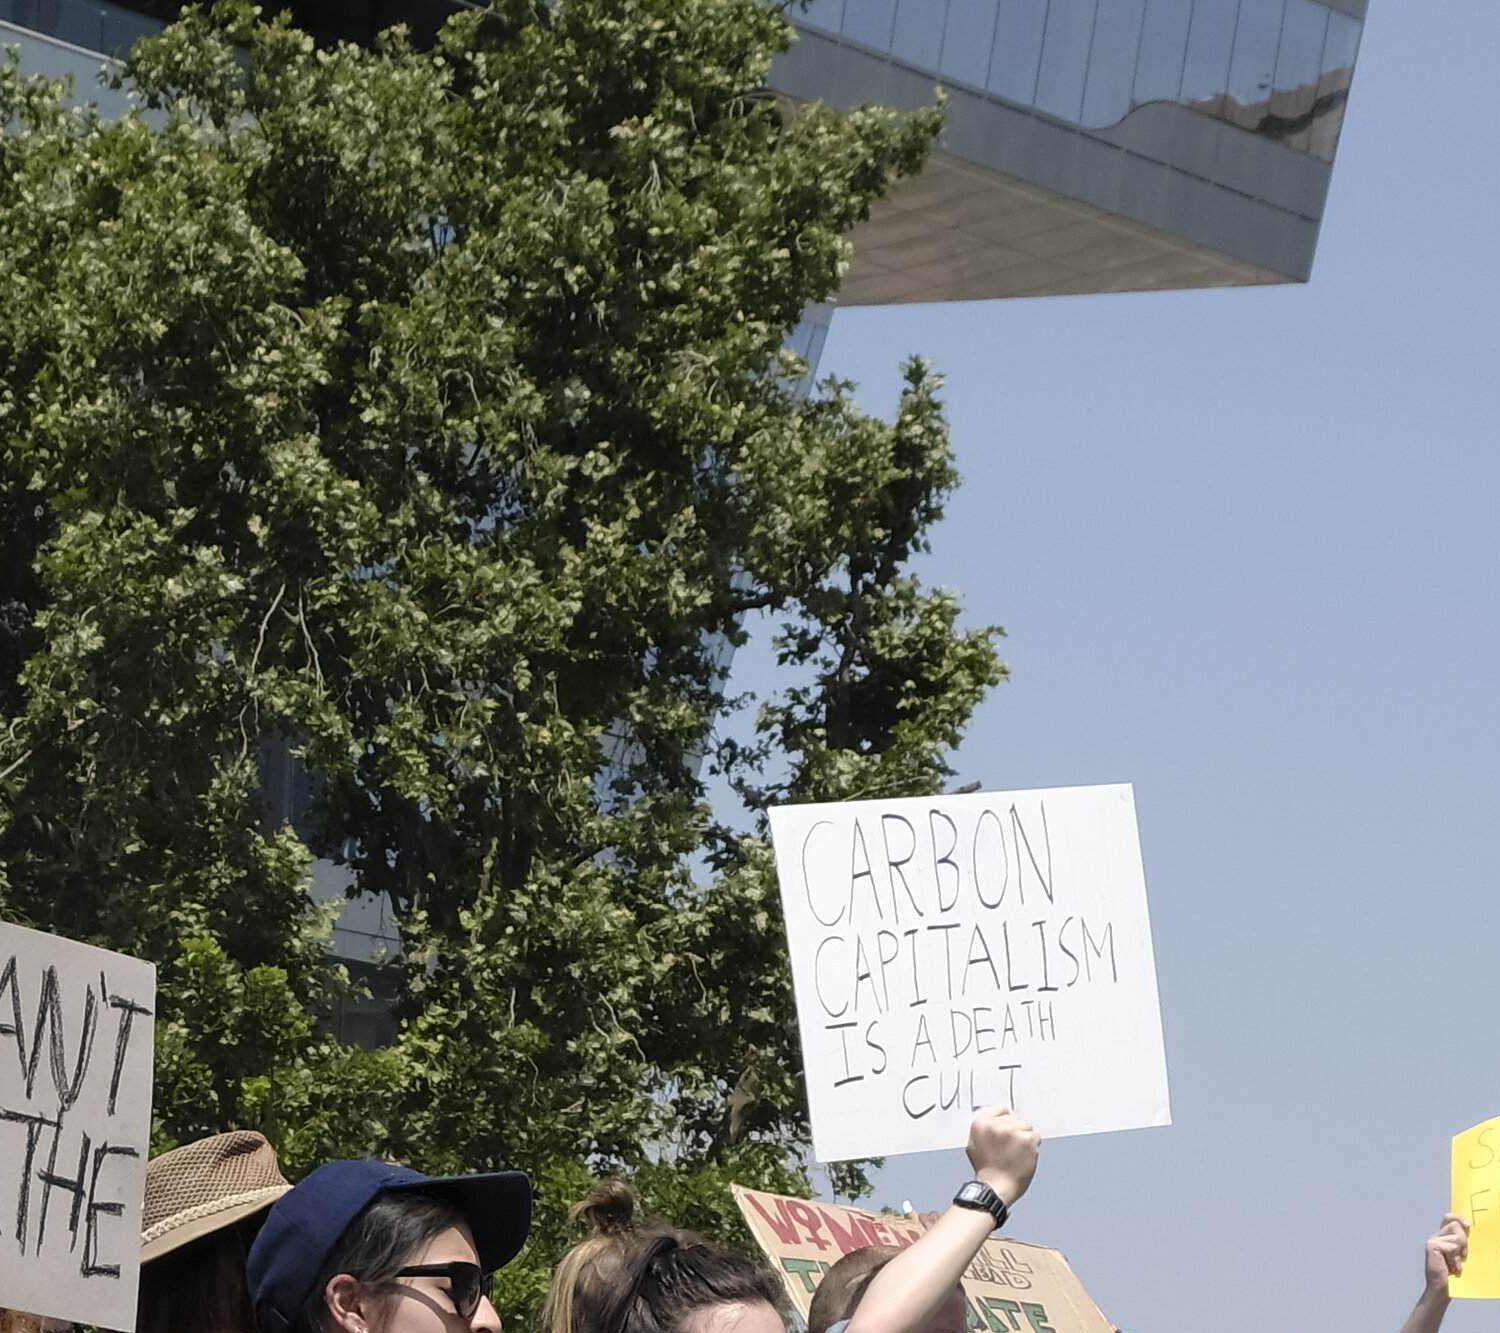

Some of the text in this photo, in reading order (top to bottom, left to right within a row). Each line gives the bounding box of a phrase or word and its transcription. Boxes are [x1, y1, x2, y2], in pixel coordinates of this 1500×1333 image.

[802, 801, 1054, 927] CARBON
[814, 916, 1118, 1018] CAPITALISM
[825, 1000, 1056, 1088] IS A DEATH
[901, 1065, 1022, 1120] CULT
